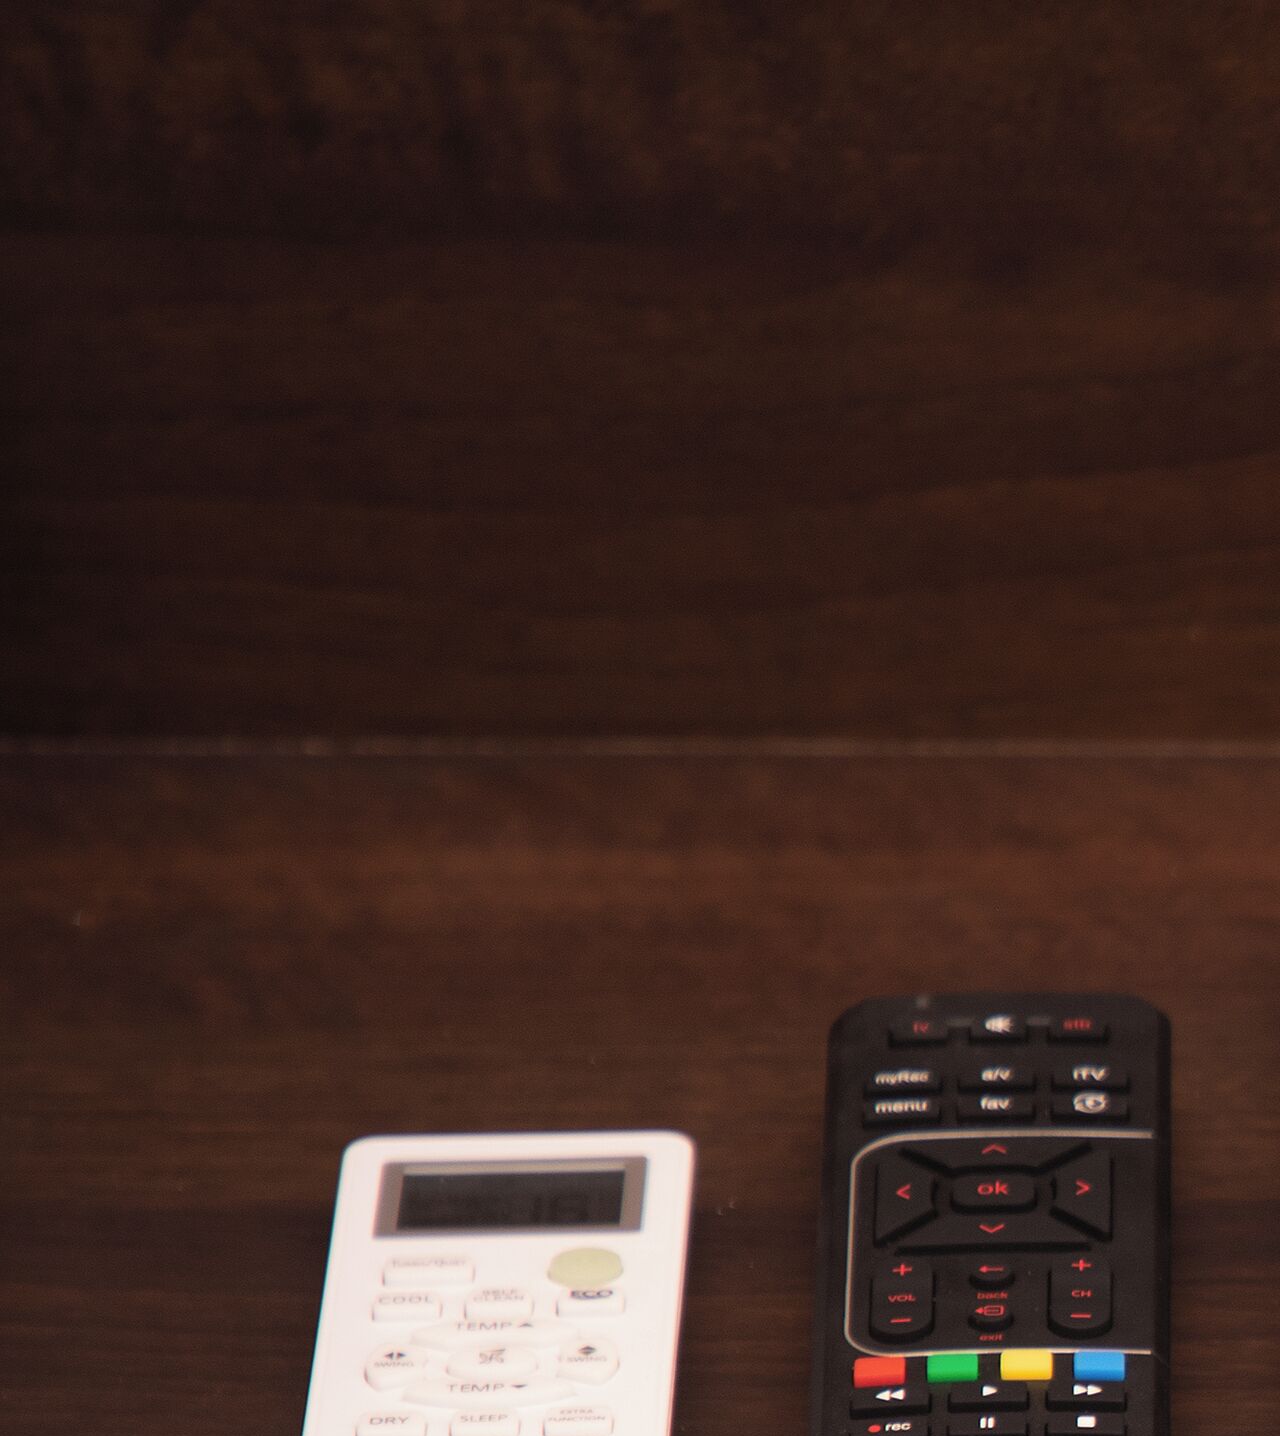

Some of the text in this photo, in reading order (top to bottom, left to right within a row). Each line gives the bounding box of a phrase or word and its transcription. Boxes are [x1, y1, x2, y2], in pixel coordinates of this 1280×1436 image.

[875, 1100, 929, 1115] menu
[980, 1096, 1011, 1111] fav
[977, 1181, 1009, 1196] ok
[569, 1288, 614, 1300] ECO
[887, 1293, 917, 1303] VOL
[976, 1291, 1009, 1300] back
[1070, 1288, 1092, 1298] CH
[378, 1295, 433, 1305] COOL
[455, 1321, 512, 1332] TEMP
[447, 1383, 505, 1393] TEMP
[369, 1416, 410, 1426] DRY
[459, 1414, 508, 1423] SLEEP
[885, 1421, 912, 1432] rec
